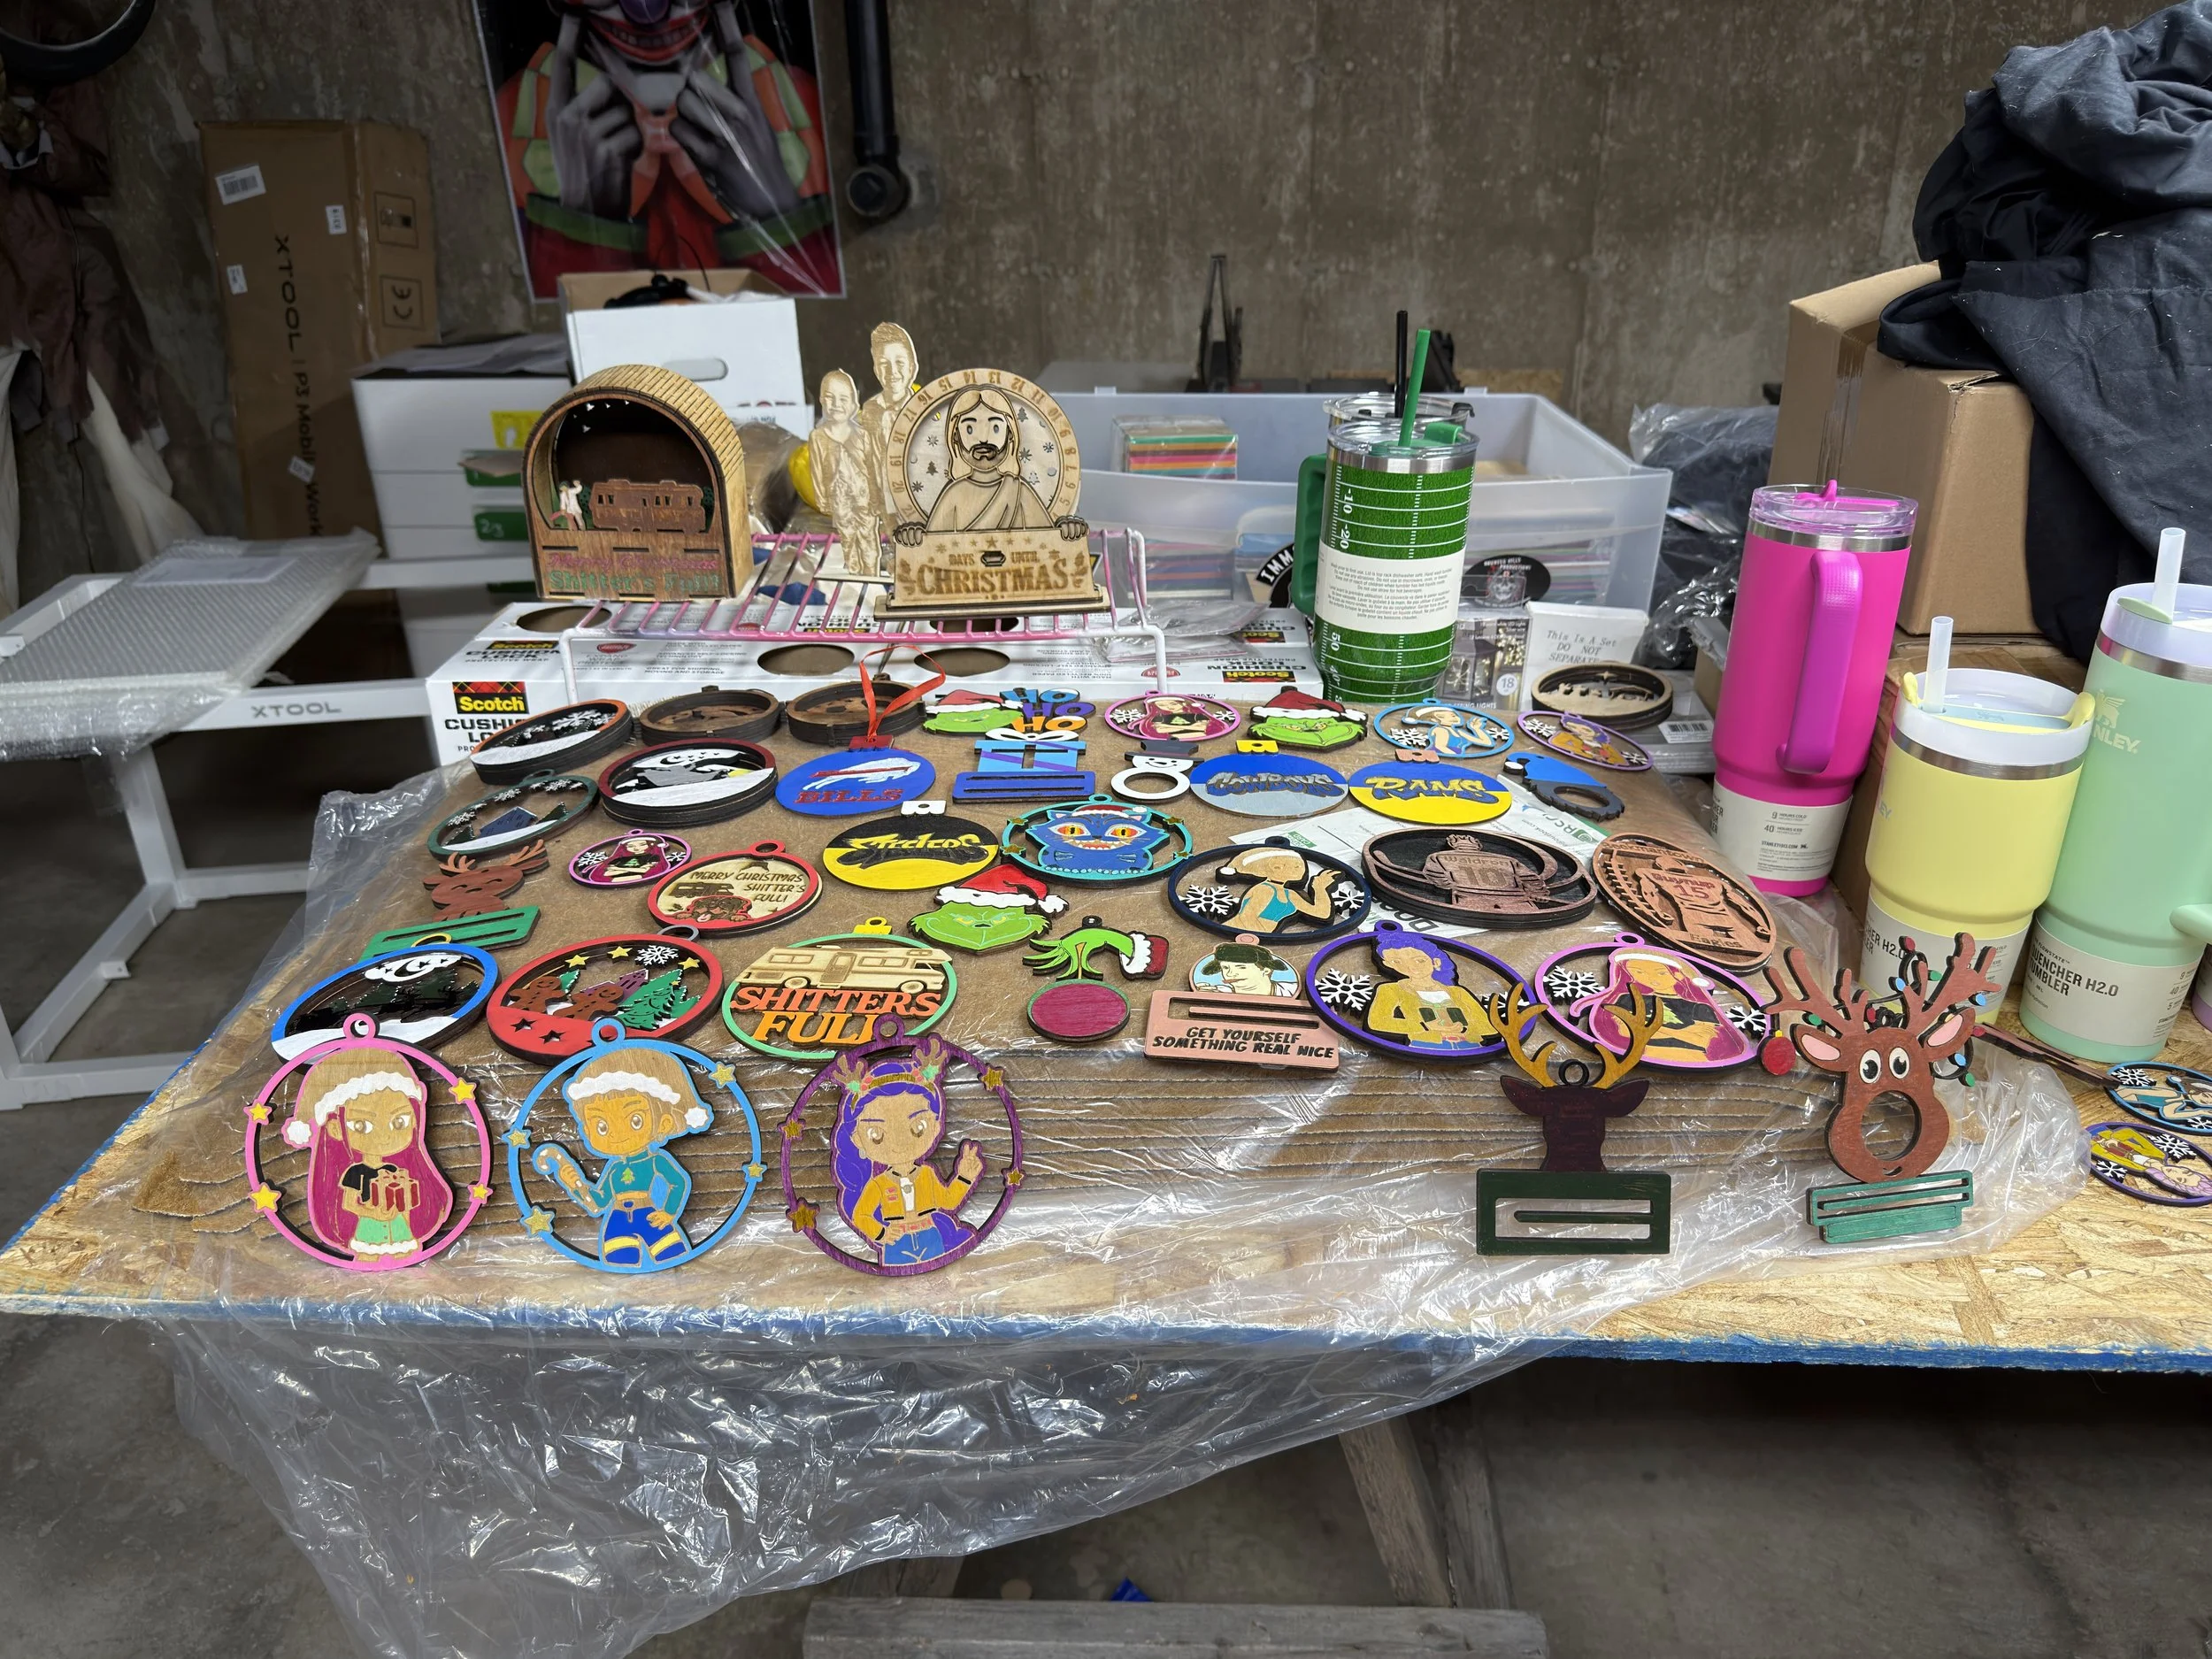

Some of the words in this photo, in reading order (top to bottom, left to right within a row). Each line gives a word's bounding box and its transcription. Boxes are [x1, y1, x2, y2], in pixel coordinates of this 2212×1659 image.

[275, 234, 302, 353] XTOOL
[296, 403, 316, 465] Mobil
[949, 553, 975, 566] DAYS
[1010, 550, 1041, 564] UNTIL
[1260, 546, 1294, 583] IMM
[918, 557, 1069, 595] CHRISTMAS
[1548, 629, 1568, 641] This
[1575, 634, 1585, 643] Is
[1588, 636, 1595, 645] A
[1600, 637, 1618, 647] Set
[1556, 641, 1571, 651] DO
[1581, 645, 1602, 656] NOT
[1501, 677, 1515, 688] 18
[459, 695, 526, 712] Scotch
[1000, 687, 1081, 704] HO
[251, 702, 342, 719] XTOOL
[1023, 702, 1096, 718] HO
[444, 718, 527, 731] CUSHI
[1010, 715, 1088, 733] HO
[2093, 726, 2142, 754] NLEY
[793, 788, 906, 804] BILLS
[1365, 776, 1499, 804] RAMS
[1764, 824, 1775, 833] 40
[690, 872, 735, 881] MERRY
[735, 872, 803, 883] CHRISTMAS
[1460, 867, 1509, 887] 10
[744, 883, 806, 893] SHITTER'S
[1673, 885, 1709, 900] 15
[754, 894, 788, 903] FULL!
[1690, 933, 1744, 949] Eagles
[2085, 978, 2119, 997] H2.0
[730, 986, 941, 1018] SHITTERS
[1186, 1026, 1217, 1039] GET
[1222, 1028, 1302, 1045] YOURSELF
[1152, 1035, 1248, 1053] SOMETHING
[1252, 1042, 1291, 1056] REAL
[1296, 1045, 1335, 1059] NICE
